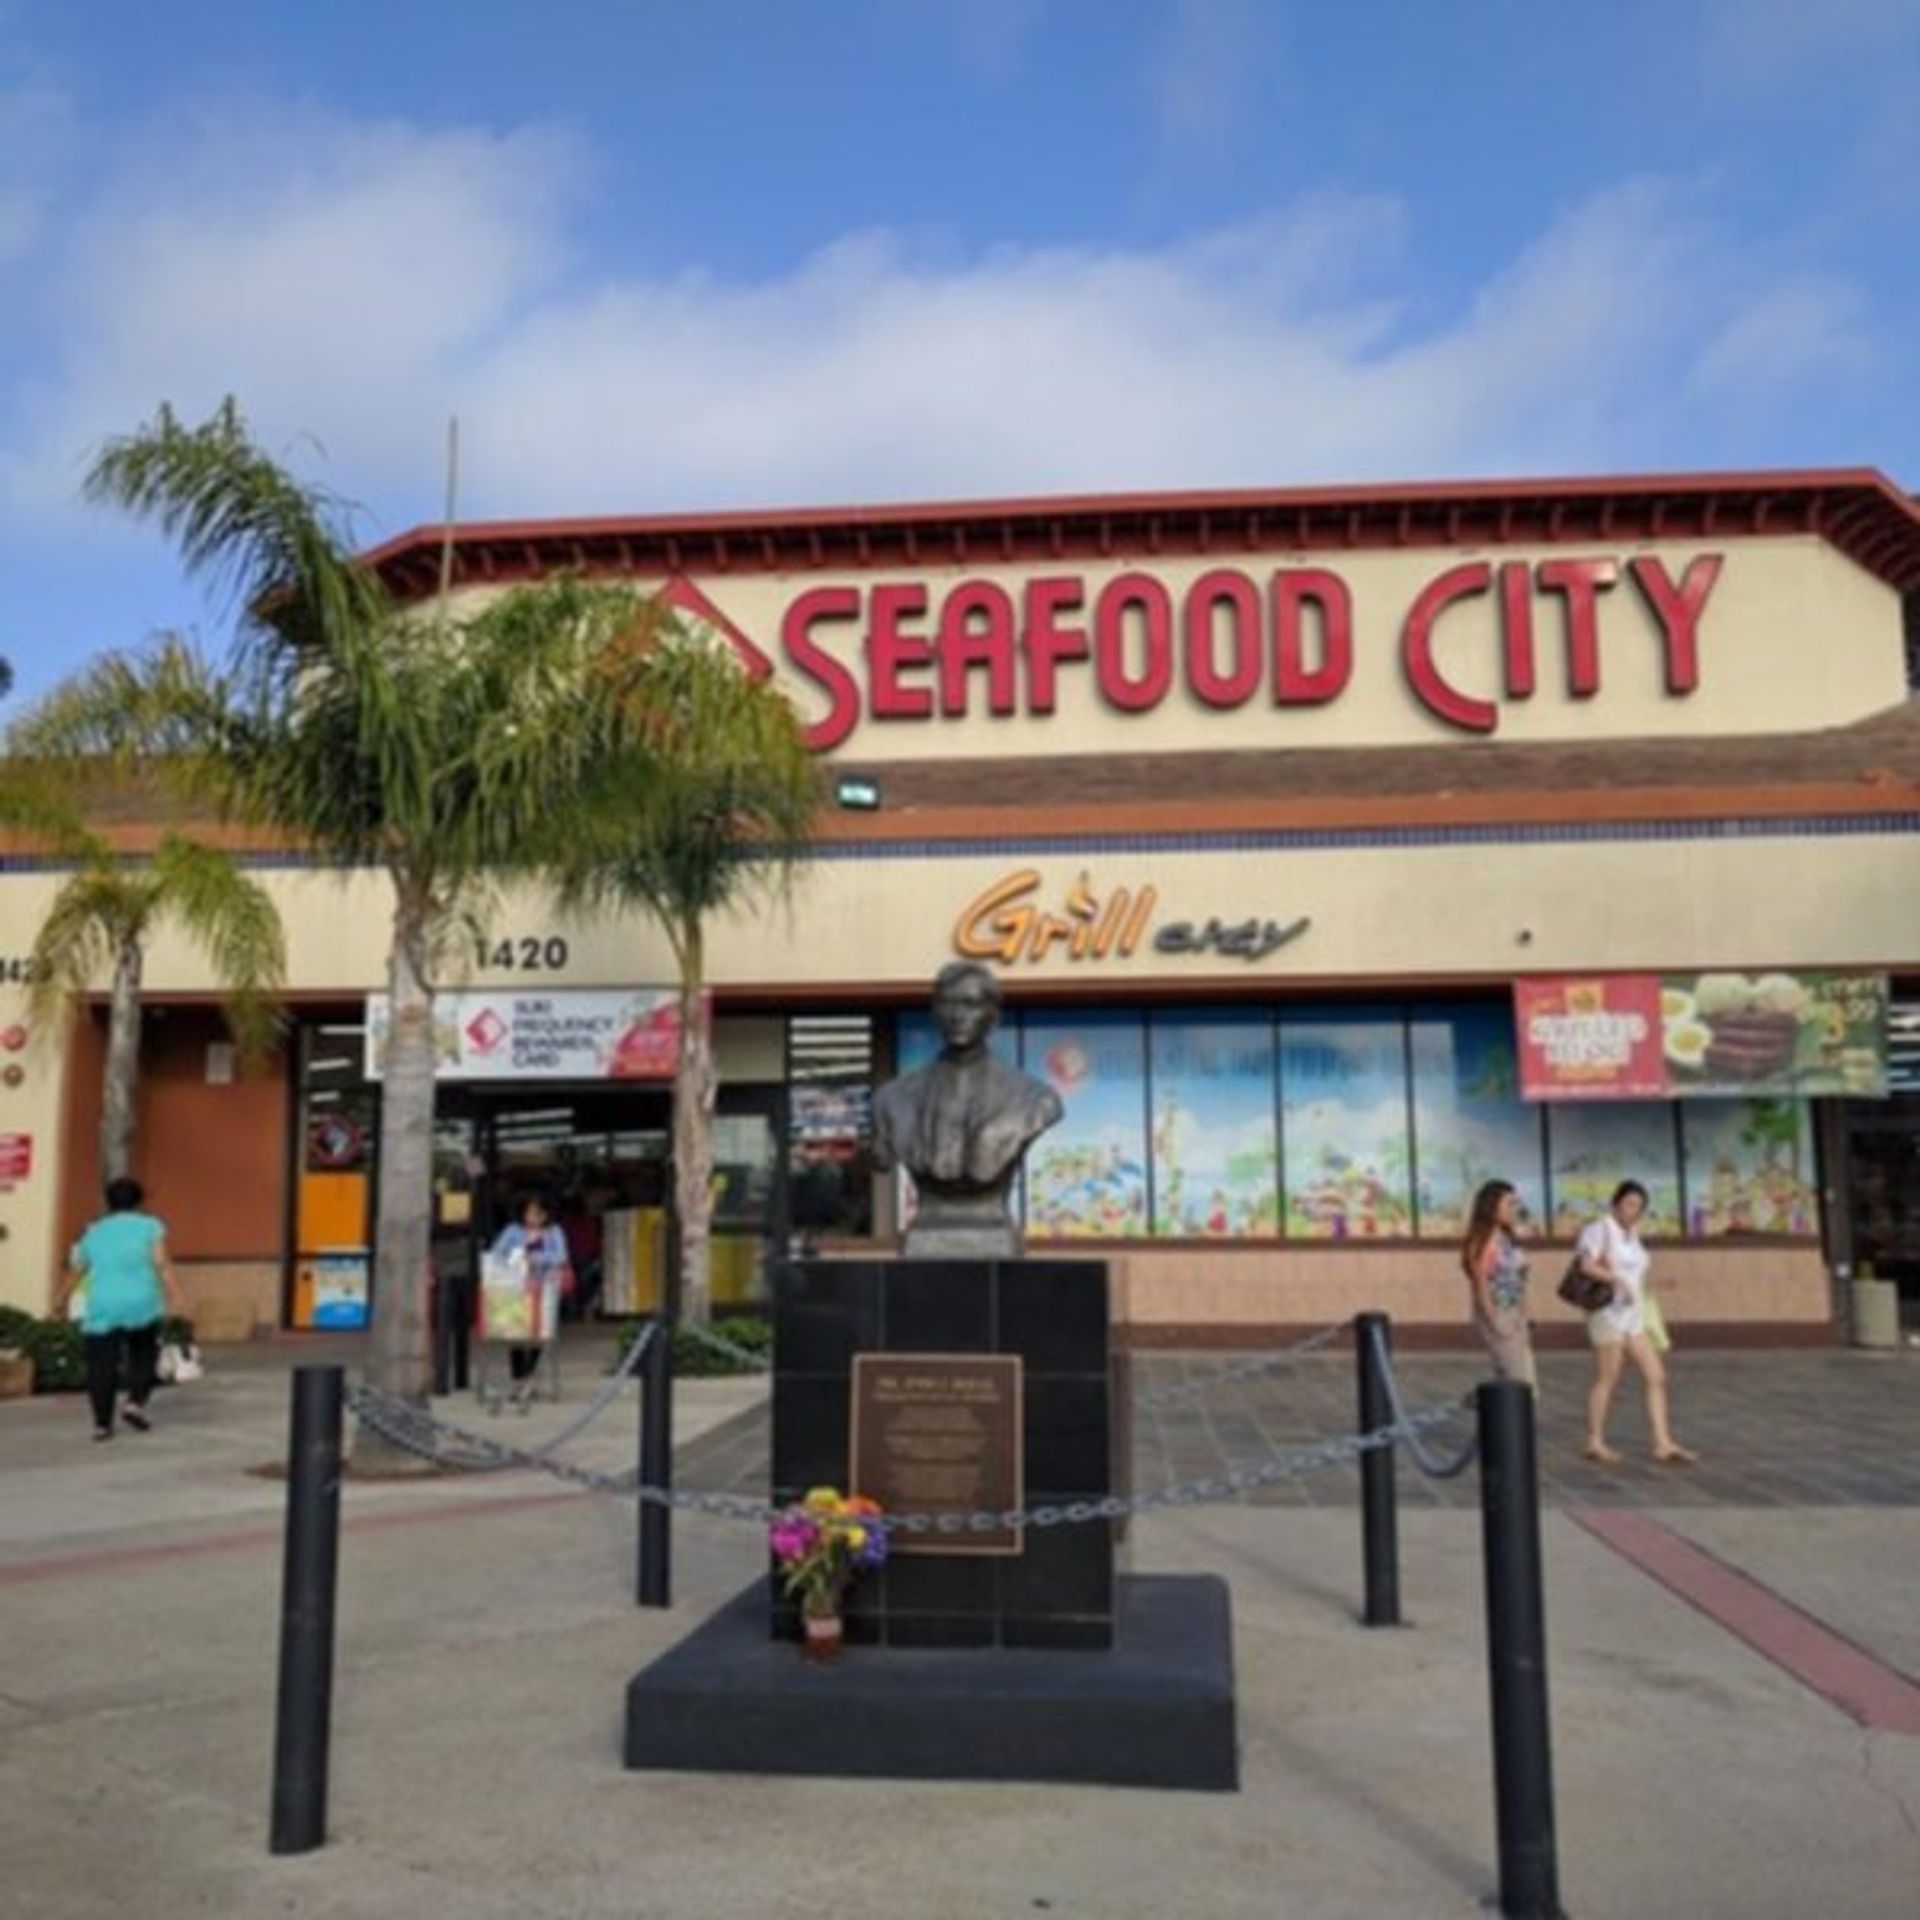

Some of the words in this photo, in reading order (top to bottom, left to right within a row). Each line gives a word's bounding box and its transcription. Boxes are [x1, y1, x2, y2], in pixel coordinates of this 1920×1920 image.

[781, 567, 1353, 752] SEAFOOD
[1400, 553, 1725, 736] CITY
[954, 868, 1158, 965] Grill
[474, 934, 568, 970] 1420
[511, 1018, 615, 1034] FREQUENCY
